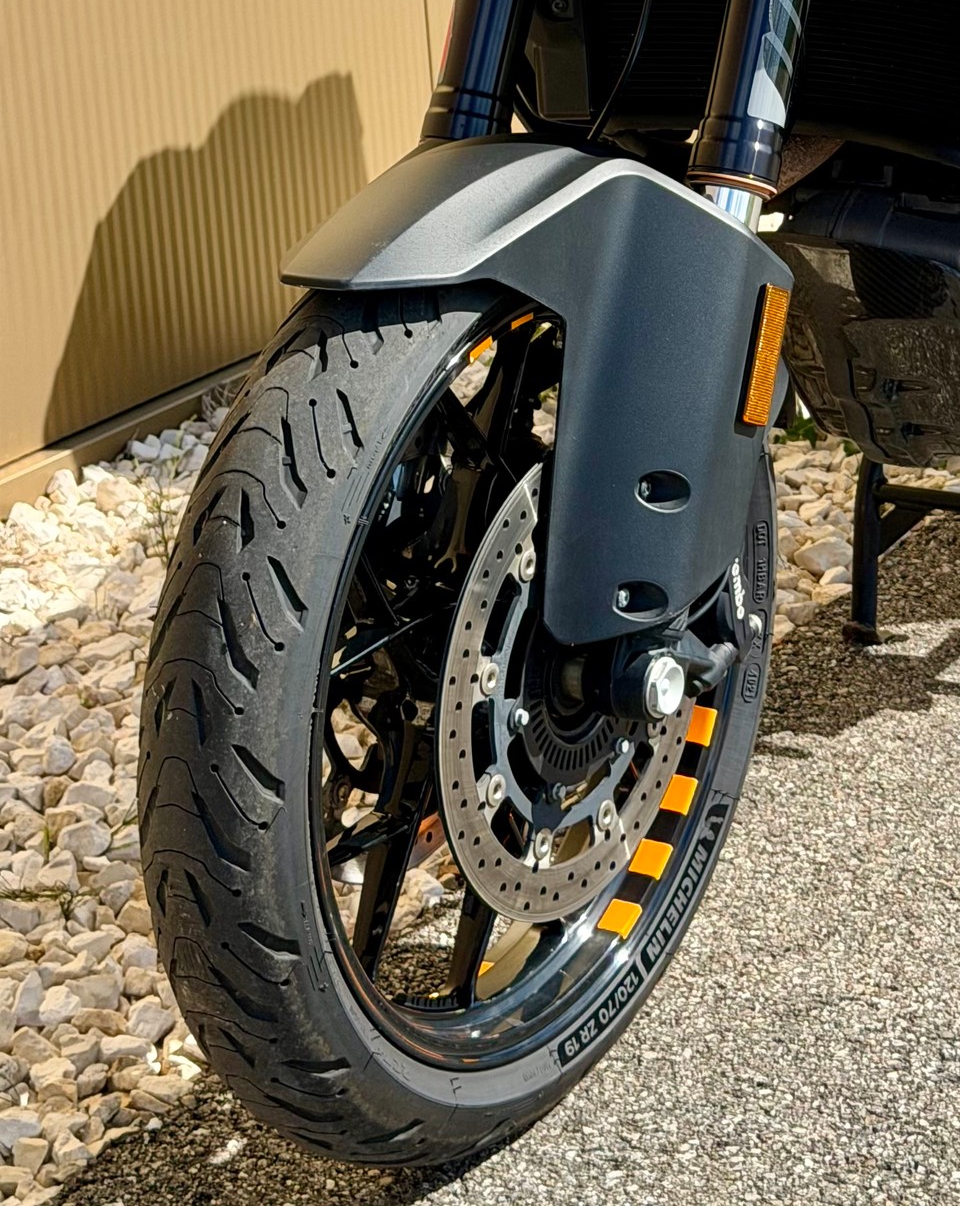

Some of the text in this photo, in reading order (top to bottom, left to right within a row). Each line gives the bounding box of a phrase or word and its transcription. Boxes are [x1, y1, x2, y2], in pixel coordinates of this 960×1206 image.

[647, 841, 709, 963] MICHELIN
[564, 971, 640, 1058] 120/70 ZR 19
